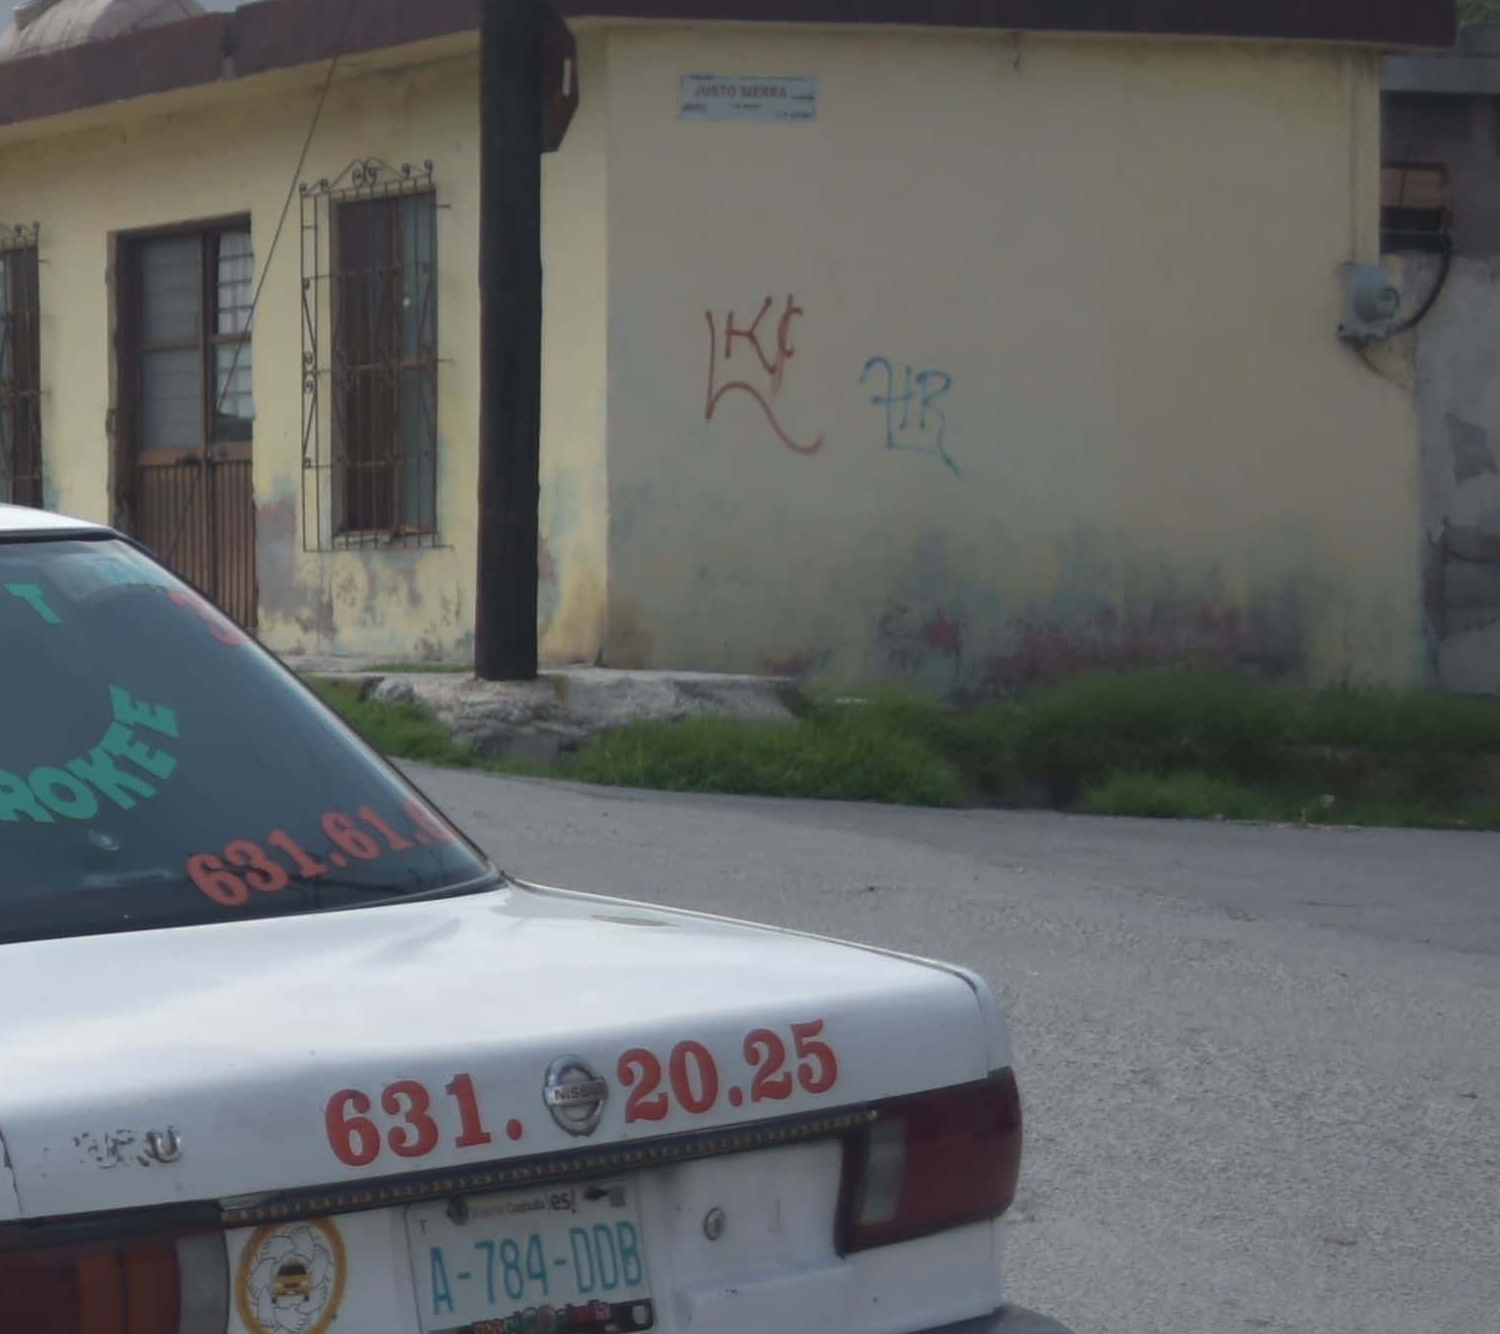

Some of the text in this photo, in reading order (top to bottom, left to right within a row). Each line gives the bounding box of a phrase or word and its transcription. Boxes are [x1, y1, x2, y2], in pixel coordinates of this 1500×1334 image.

[694, 84, 788, 99] JUSTO SIERRA
[4, 581, 62, 625] T
[324, 1020, 840, 1167] 631. 20.25
[429, 1220, 642, 1316] A-784-DDB
